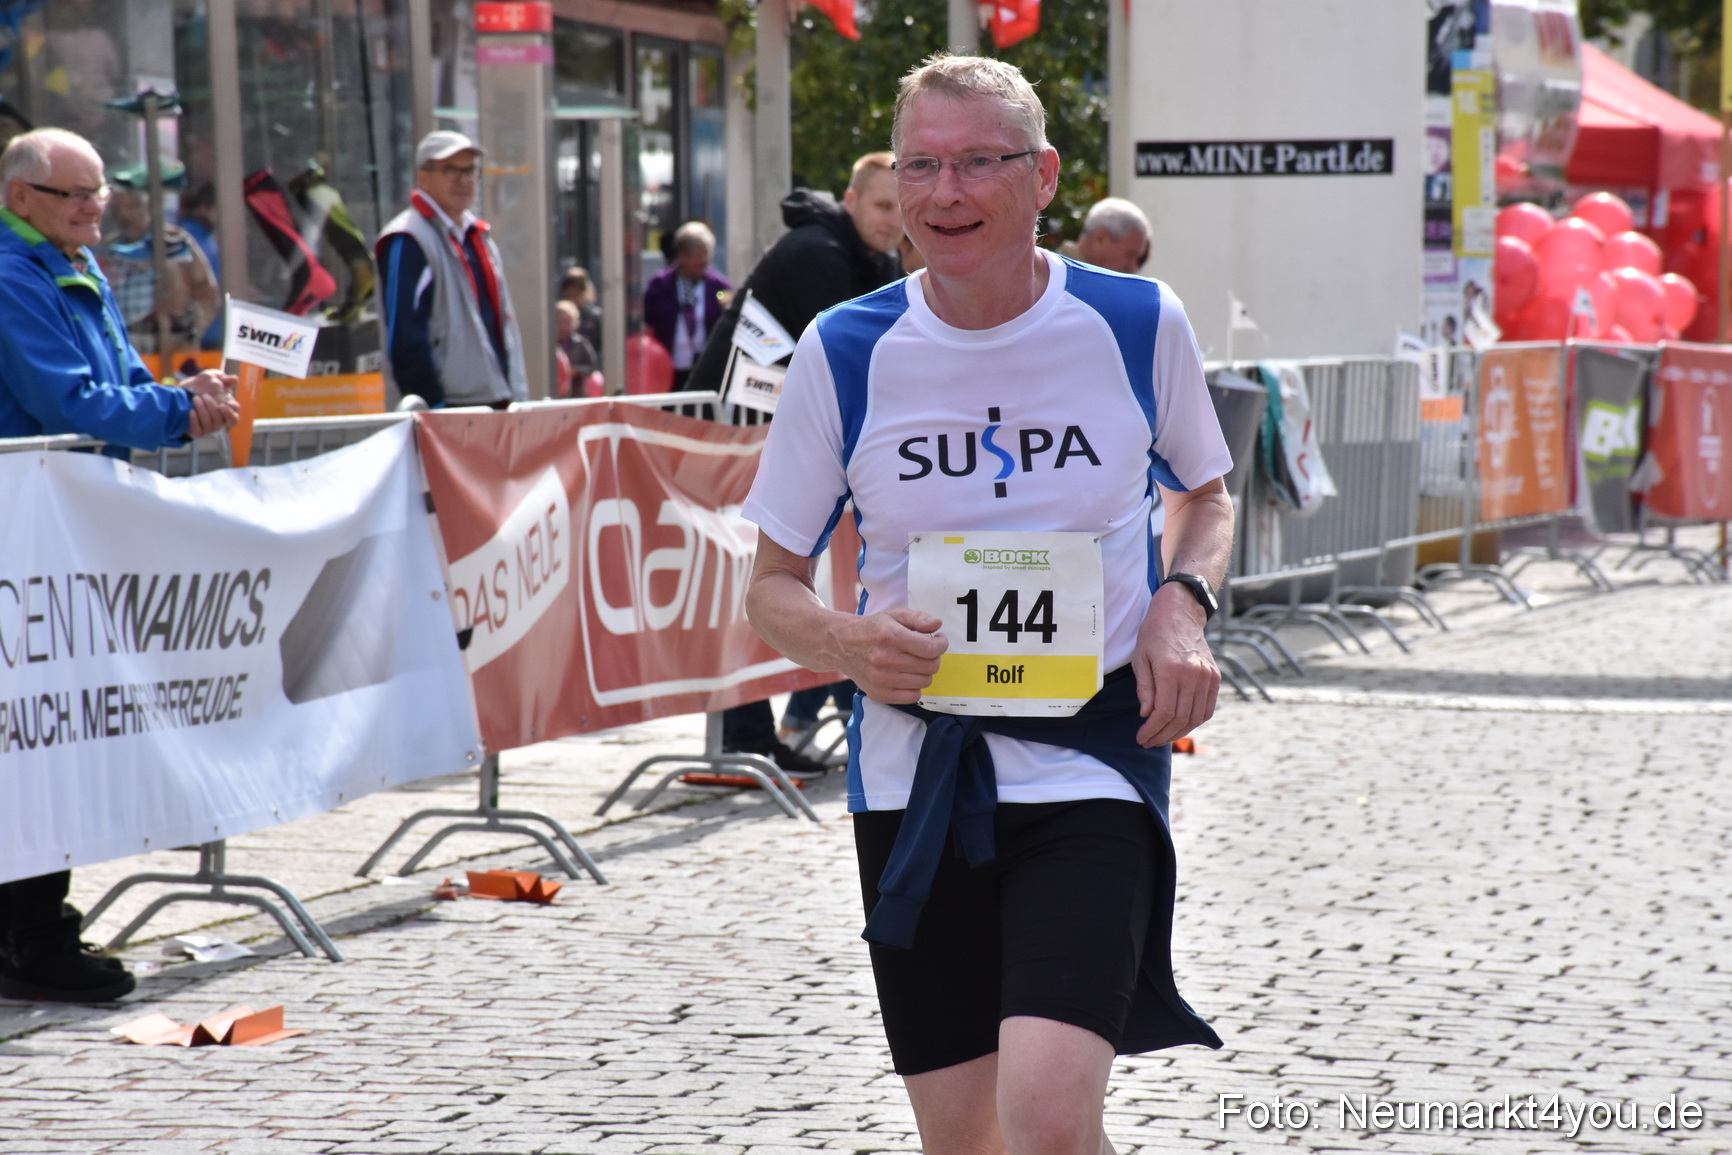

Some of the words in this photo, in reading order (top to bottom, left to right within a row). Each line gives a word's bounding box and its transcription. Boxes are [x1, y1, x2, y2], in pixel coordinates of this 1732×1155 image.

[237, 325, 281, 348] swn
[898, 424, 1103, 482] SUSPA
[454, 558, 509, 635] DAS
[515, 502, 562, 612] NEUE
[983, 549, 1050, 565] BOCK
[956, 588, 1058, 644] 144
[986, 664, 1025, 684] Rolf
